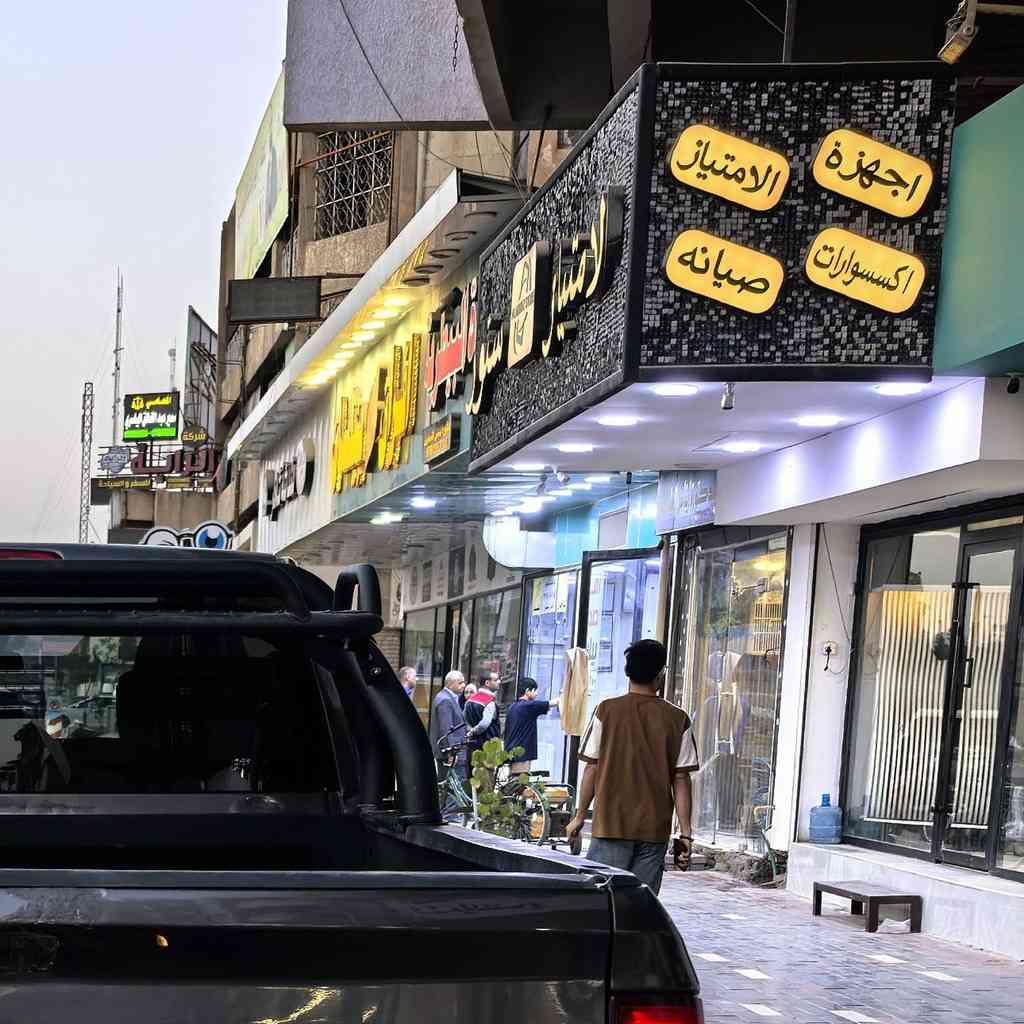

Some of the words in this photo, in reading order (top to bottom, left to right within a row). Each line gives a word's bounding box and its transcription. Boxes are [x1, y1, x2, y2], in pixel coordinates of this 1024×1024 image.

[676, 139, 782, 197] الامتياز
[825, 140, 923, 201] اجهزة
[678, 246, 770, 294] صيانه
[813, 244, 915, 294] اكسسوارات
